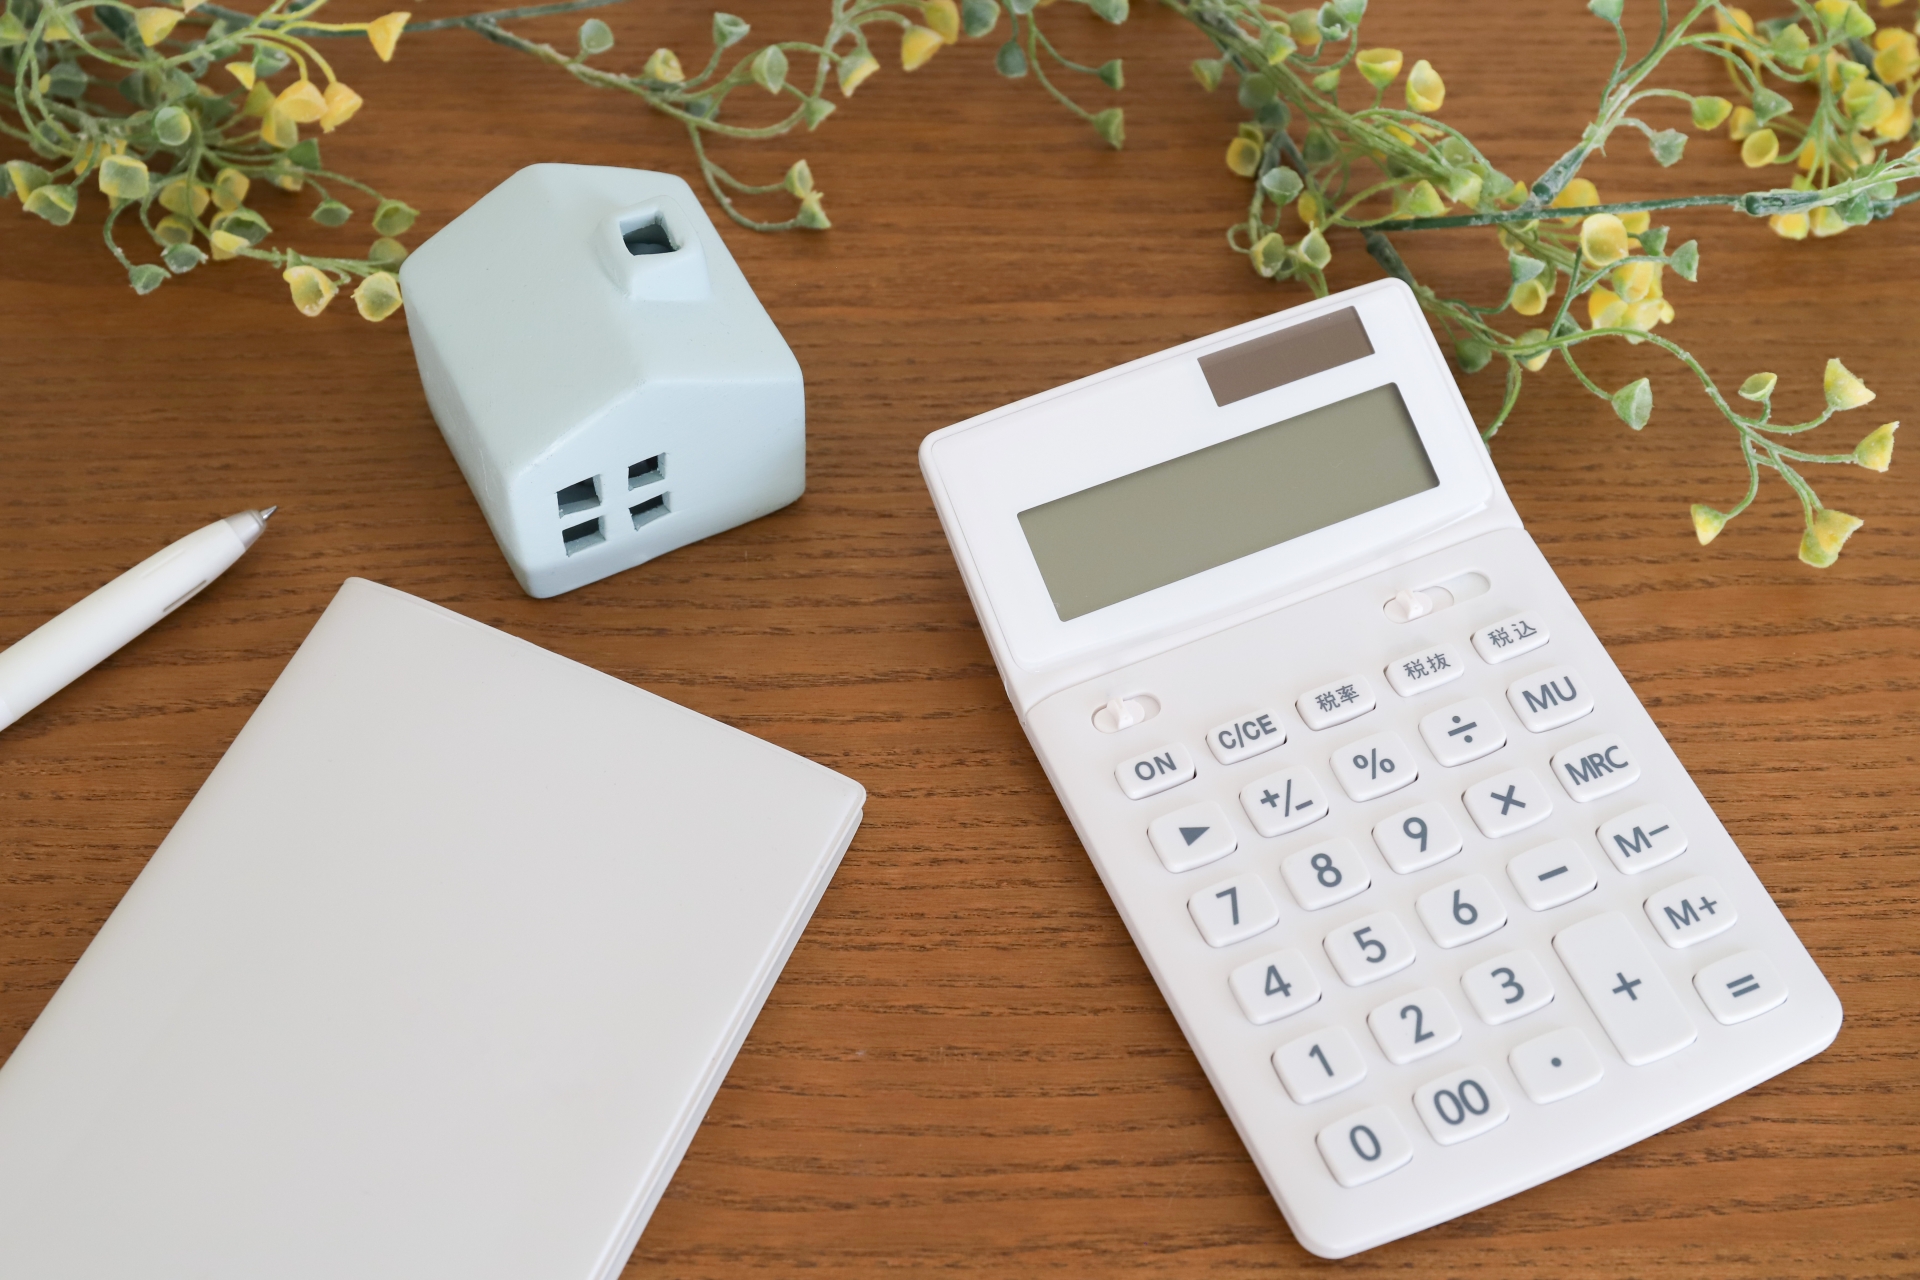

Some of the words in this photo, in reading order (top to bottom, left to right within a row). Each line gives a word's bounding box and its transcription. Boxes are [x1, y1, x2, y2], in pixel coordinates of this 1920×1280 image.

[1487, 619, 1538, 648] 税込
[1403, 653, 1451, 680] 税抜
[1315, 683, 1360, 713] 税率
[1521, 676, 1578, 714] MU
[1218, 714, 1277, 750] C/CE
[1134, 752, 1178, 781] ON
[1352, 748, 1396, 780] %
[1563, 745, 1629, 786] MRC
[1402, 816, 1428, 853] 9
[1310, 853, 1343, 888] 8
[1215, 887, 1240, 926] 7
[1452, 889, 1479, 926] 6
[1663, 896, 1718, 931] M+
[1353, 926, 1387, 964] 5
[1264, 964, 1292, 998] 4
[1490, 967, 1525, 1005] 3
[1399, 1004, 1435, 1044] 2
[1308, 1043, 1335, 1078] 1
[1432, 1078, 1491, 1126] 00
[1348, 1124, 1382, 1163] 0
